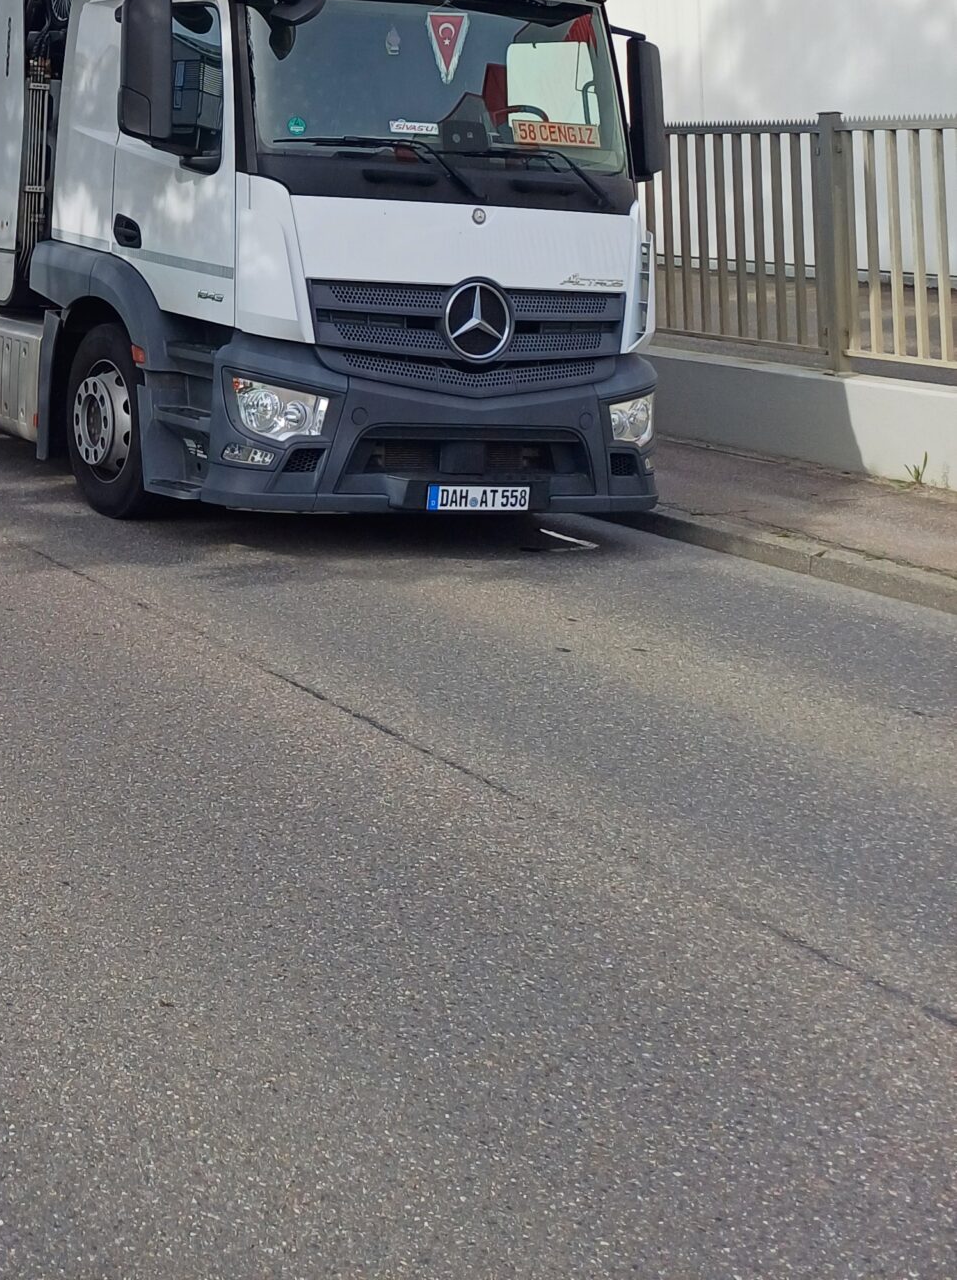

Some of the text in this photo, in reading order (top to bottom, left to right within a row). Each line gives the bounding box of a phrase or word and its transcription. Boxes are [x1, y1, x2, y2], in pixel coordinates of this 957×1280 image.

[518, 123, 537, 141] 58
[440, 489, 469, 508] DAH
[479, 489, 499, 508] AT
[500, 489, 528, 508] 558
